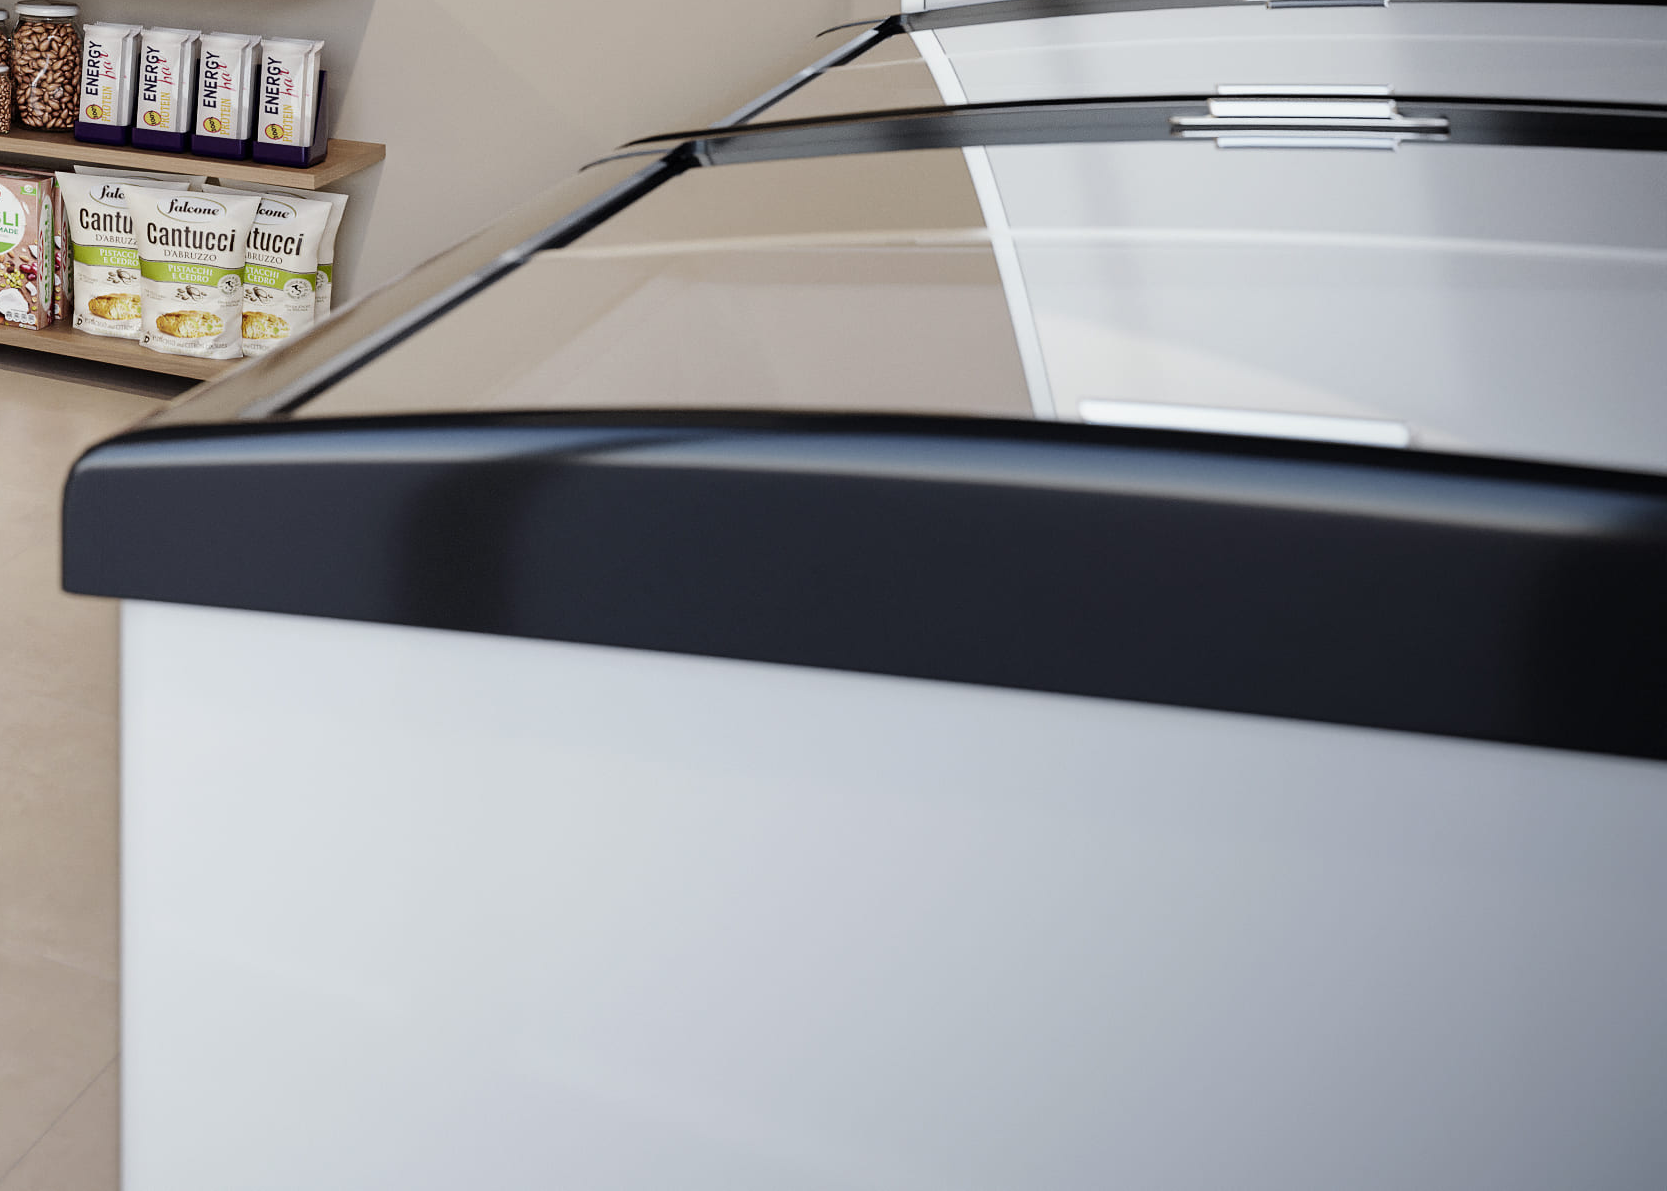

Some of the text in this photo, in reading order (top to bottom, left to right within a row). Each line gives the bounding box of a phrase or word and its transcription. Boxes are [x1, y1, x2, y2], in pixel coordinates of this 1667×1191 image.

[85, 41, 102, 96] ENERGY
[143, 46, 160, 102] ENERGY
[202, 51, 220, 108] ENERGY
[265, 57, 282, 115] ENERGY
[101, 85, 114, 122] PROTEIN
[160, 91, 171, 129] PROTEIN
[220, 97, 232, 135] PROTEIN
[283, 103, 294, 143] PROTEIN
[100, 185, 125, 200] falc
[167, 199, 219, 216] falcone
[257, 202, 290, 219] lcone
[79, 208, 133, 234] Cantu
[95, 233, 138, 246] D'ABRUZZ
[147, 223, 236, 252] Cantucci
[247, 227, 304, 256] tucci
[99, 248, 139, 259] PISTACC
[108, 256, 139, 267] CEDRO
[164, 248, 217, 261] D'ABRUZZO
[245, 252, 283, 265] BRUZZO
[168, 264, 213, 277] PISTACCHI
[177, 272, 210, 283] CEDRO
[245, 266, 280, 280] STACCHI
[247, 274, 276, 285] CEDRO
